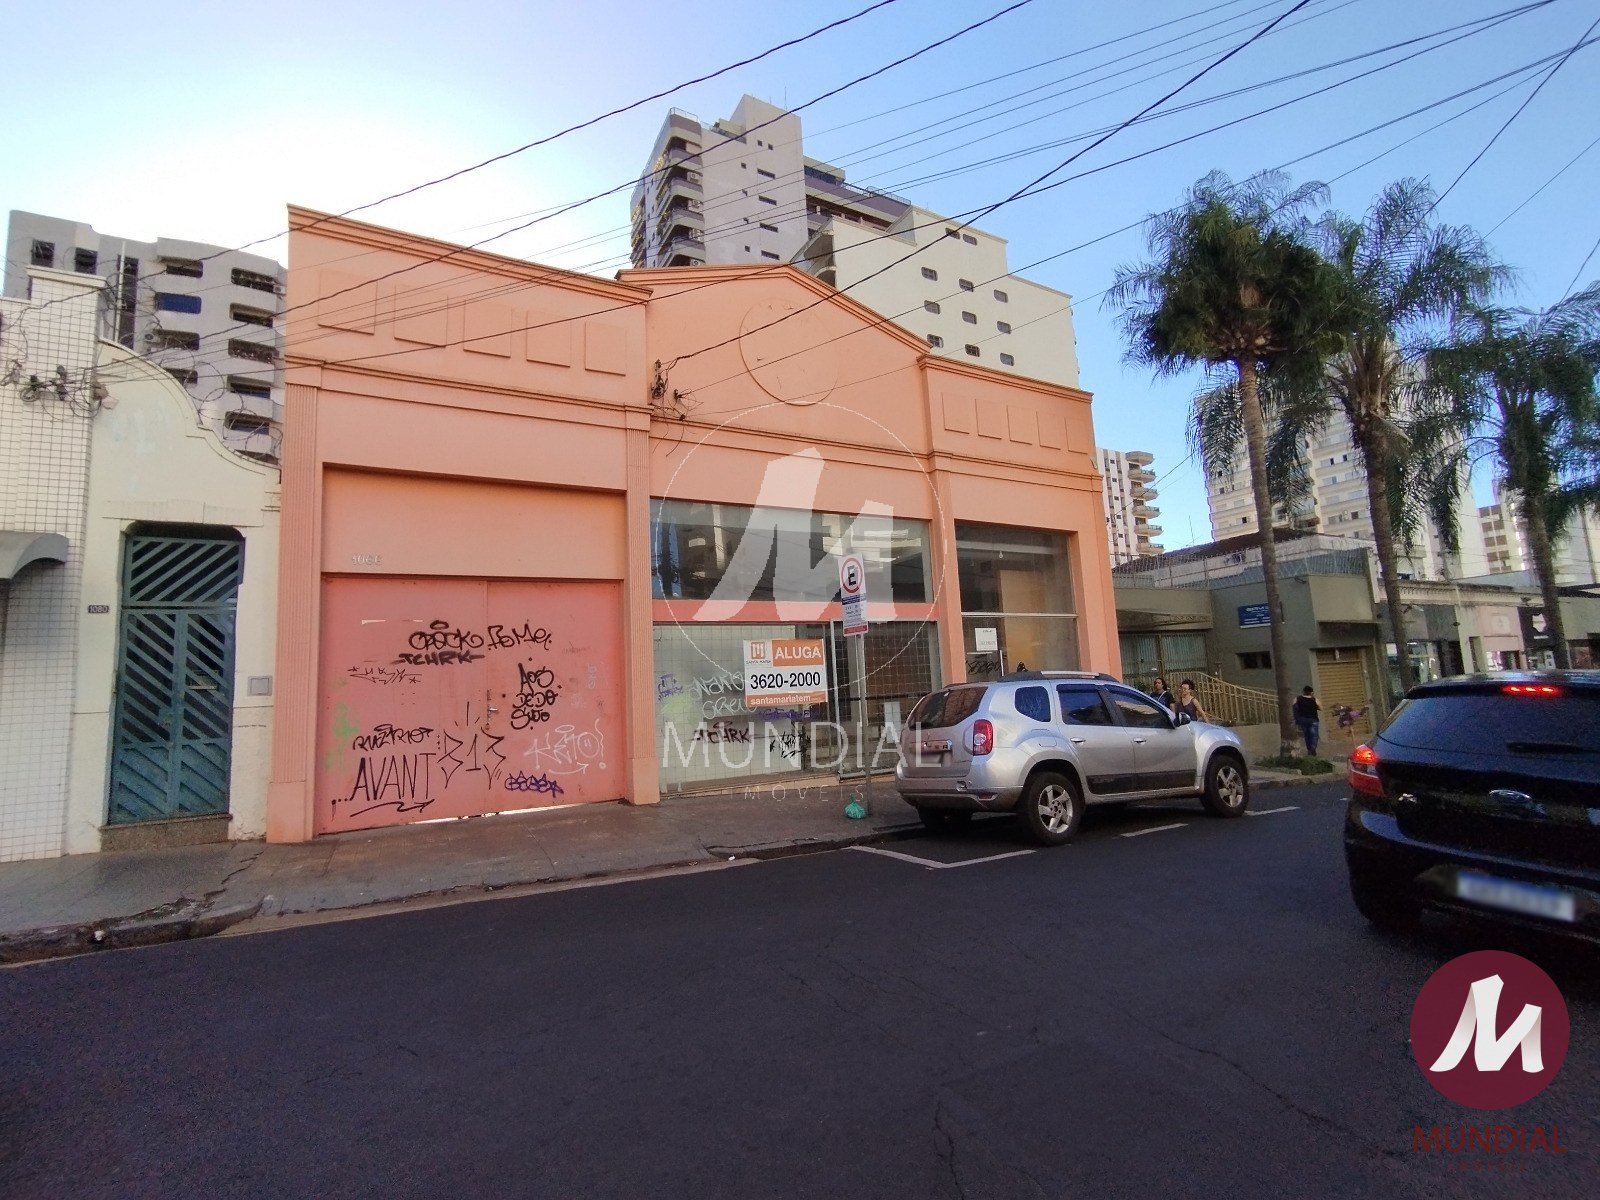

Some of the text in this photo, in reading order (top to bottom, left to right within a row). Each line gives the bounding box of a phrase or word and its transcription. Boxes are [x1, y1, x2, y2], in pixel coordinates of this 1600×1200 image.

[847, 565, 857, 586] E
[775, 646, 821, 659] ALUGA
[750, 672, 821, 689] 3620-2000
